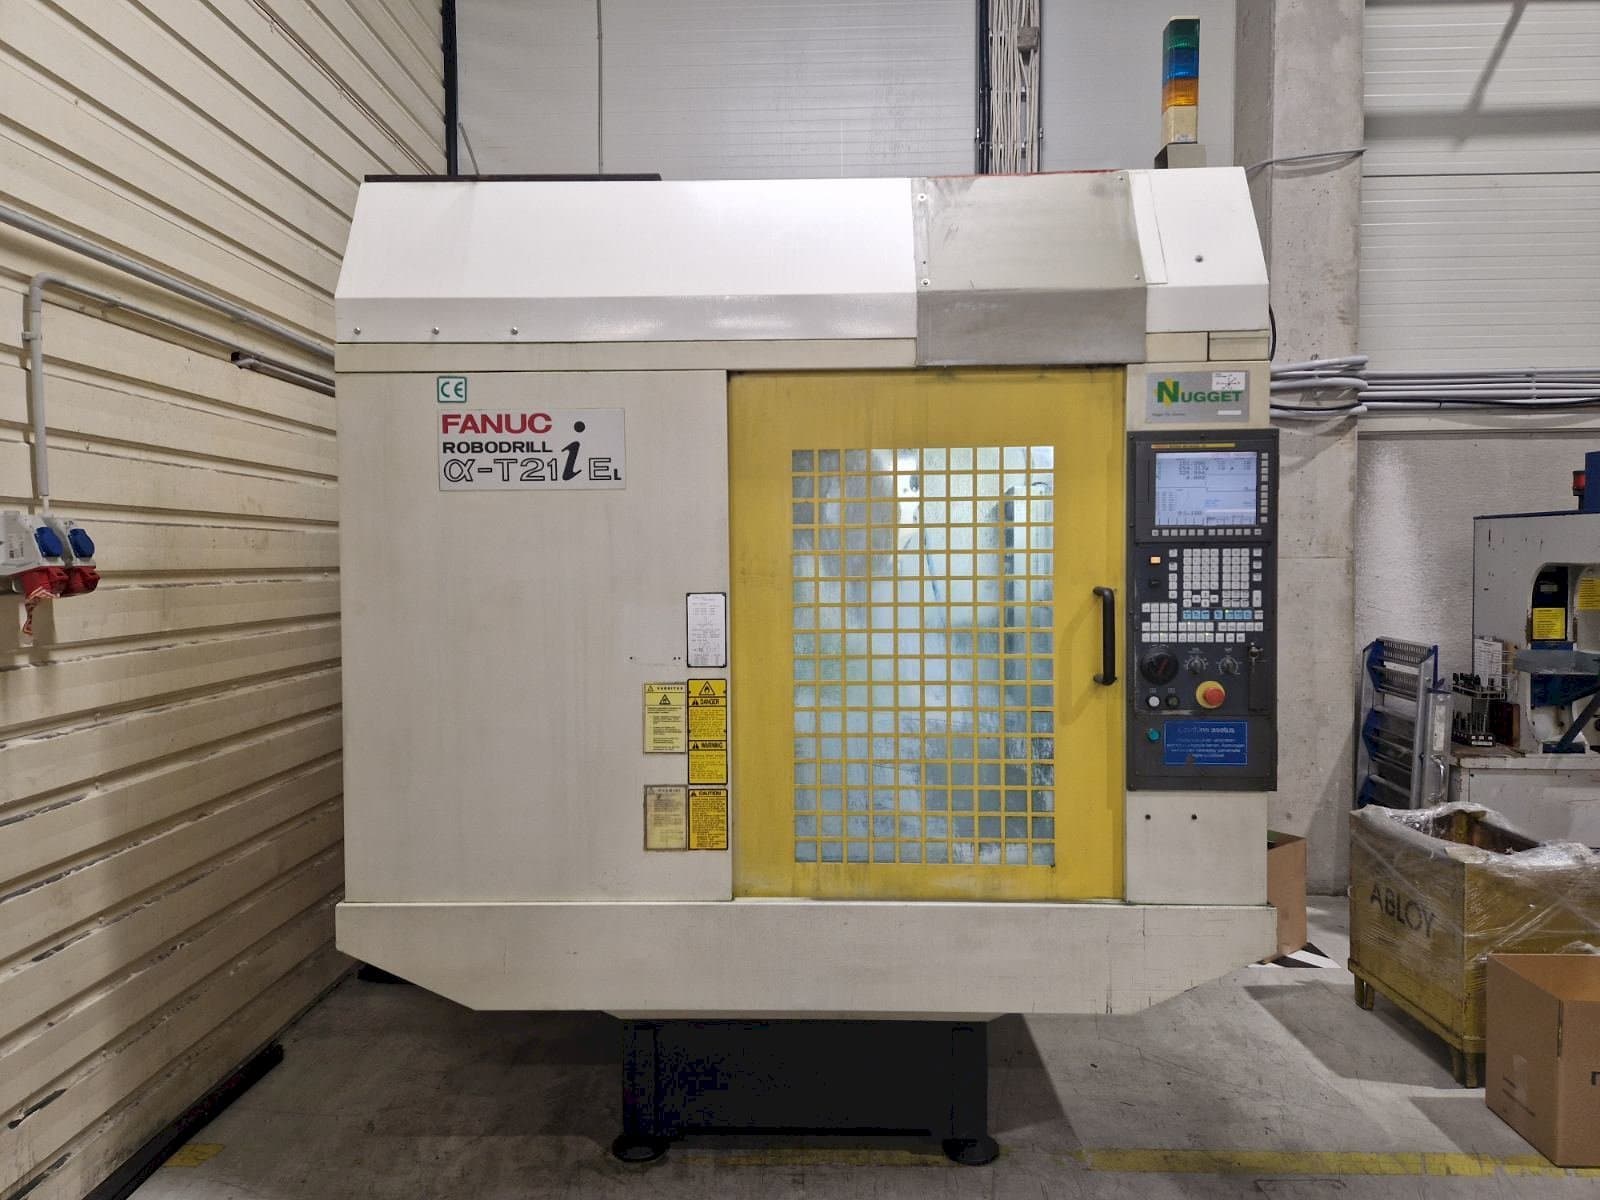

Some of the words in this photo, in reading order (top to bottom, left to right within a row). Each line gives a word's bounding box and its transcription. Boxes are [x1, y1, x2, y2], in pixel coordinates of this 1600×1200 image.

[1157, 381, 1243, 403] NUGGET
[442, 413, 553, 434] FANUC
[442, 441, 553, 454] ROBODRILL
[1370, 884, 1437, 938] ABLOY
